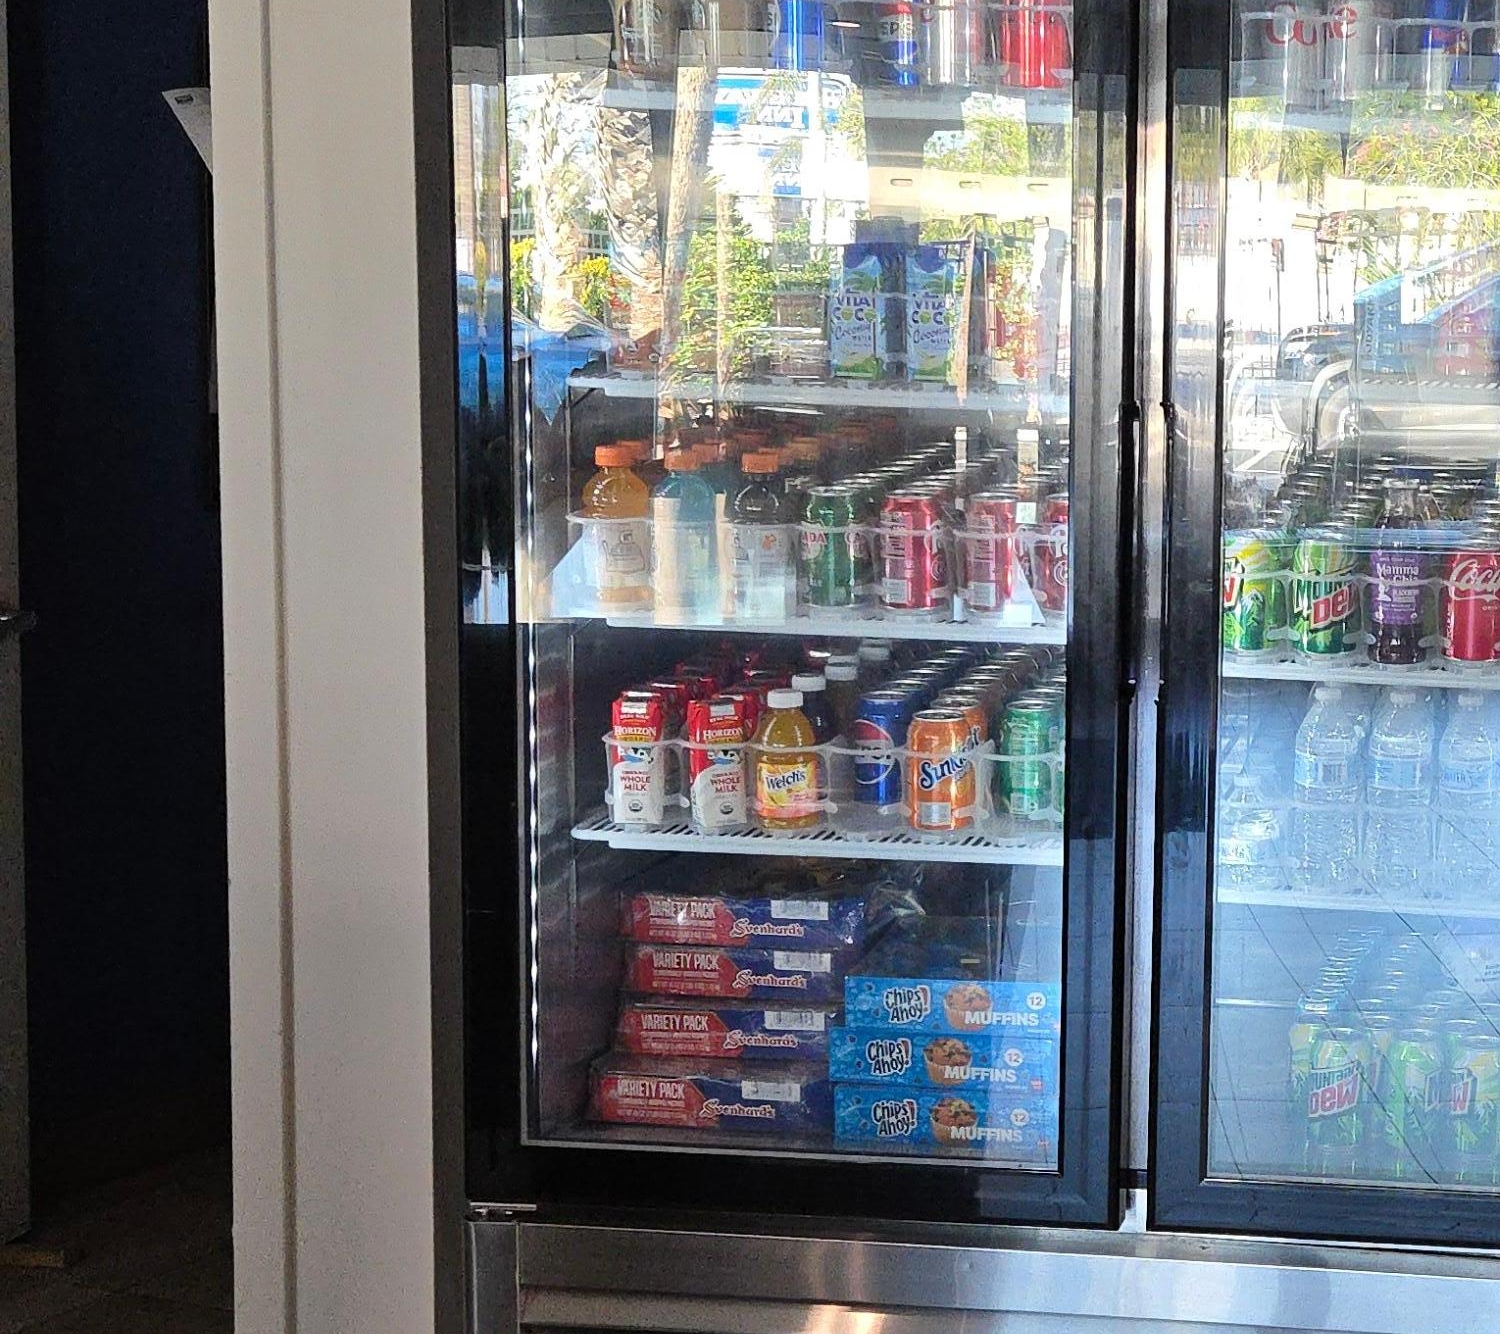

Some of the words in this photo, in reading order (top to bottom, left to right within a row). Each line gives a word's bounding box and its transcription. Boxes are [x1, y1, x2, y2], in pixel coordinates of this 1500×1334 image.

[1376, 563, 1420, 576] Mamma
[613, 725, 658, 737] HORIZON
[703, 726, 744, 740] HORIZON
[620, 775, 651, 784] WHOLE
[623, 782, 648, 792] MILK
[710, 776, 740, 786] WHOLE
[765, 769, 807, 789] Welch's
[714, 784, 739, 794] MILK
[649, 900, 690, 918] VARIETY
[690, 901, 717, 919] PACK
[730, 918, 805, 938] Svenhard's
[652, 951, 692, 969] VARIETY
[693, 953, 720, 970] PACK
[732, 969, 808, 989] Svenhard's
[884, 986, 922, 1009] Chips
[1028, 995, 1043, 1007] 12
[889, 998, 931, 1024] Ahoy!
[964, 1011, 1040, 1027] MUFFINS
[640, 1013, 682, 1030] VARIETY
[682, 1015, 709, 1032] PACK
[723, 1029, 799, 1049] Svenhard's
[866, 1040, 903, 1063] Chips
[1007, 1052, 1021, 1064] 12
[871, 1052, 912, 1076] Ahoy!
[943, 1066, 1018, 1083] MUFFINS
[617, 1079, 657, 1097] VARIETY
[657, 1082, 685, 1100] PACK
[700, 1098, 776, 1118] Svenhard's
[872, 1100, 909, 1124] Chips
[877, 1113, 918, 1137] Ahoy!
[949, 1126, 1024, 1143] MUFFINS
